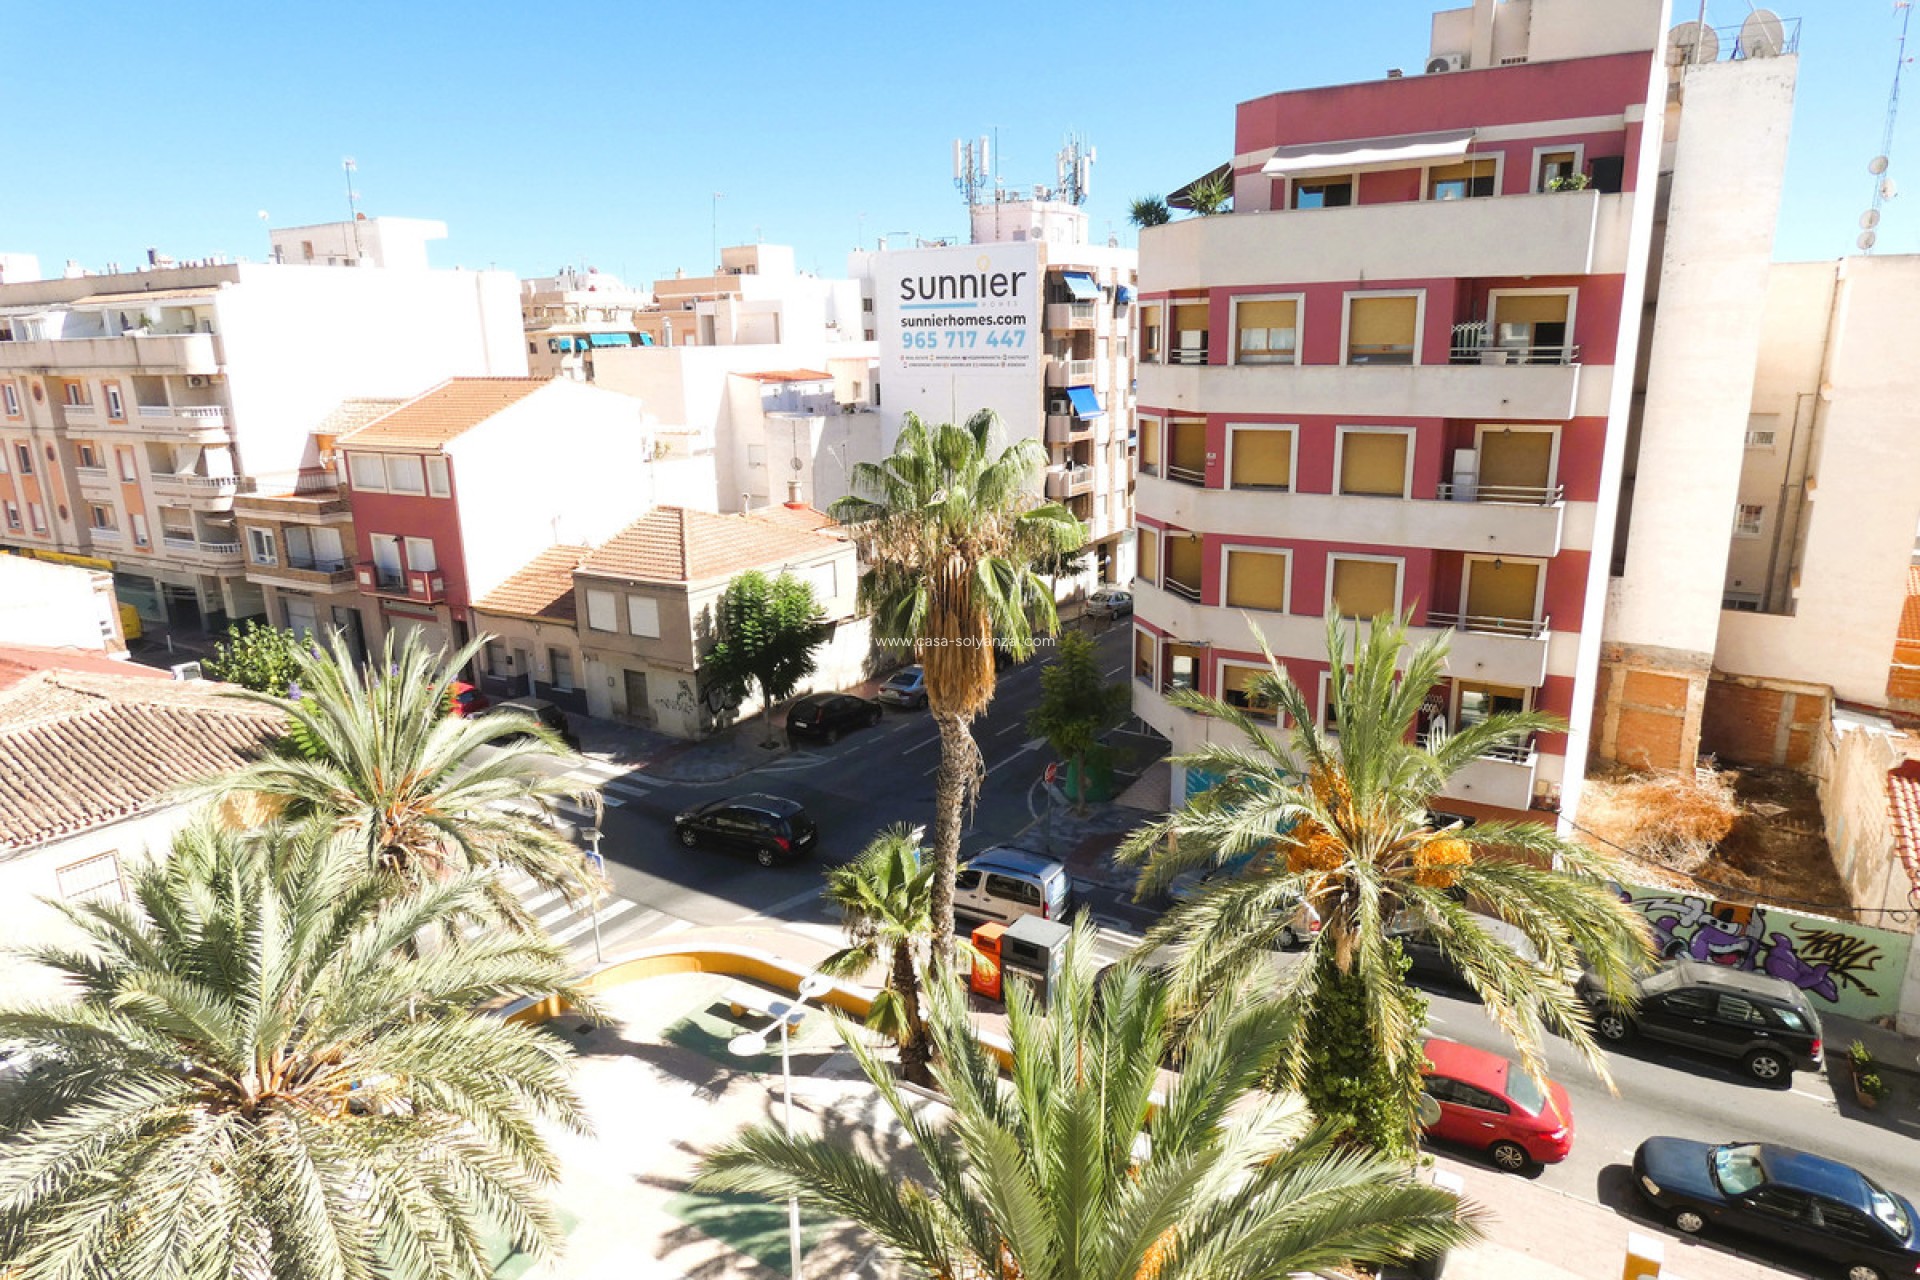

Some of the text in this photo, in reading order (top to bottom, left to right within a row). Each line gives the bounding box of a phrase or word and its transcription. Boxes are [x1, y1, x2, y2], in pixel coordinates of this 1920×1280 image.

[900, 256, 1027, 300] sunnier
[900, 314, 1026, 327] sunnierhomes.com
[902, 330, 1026, 349] 965 717 447
